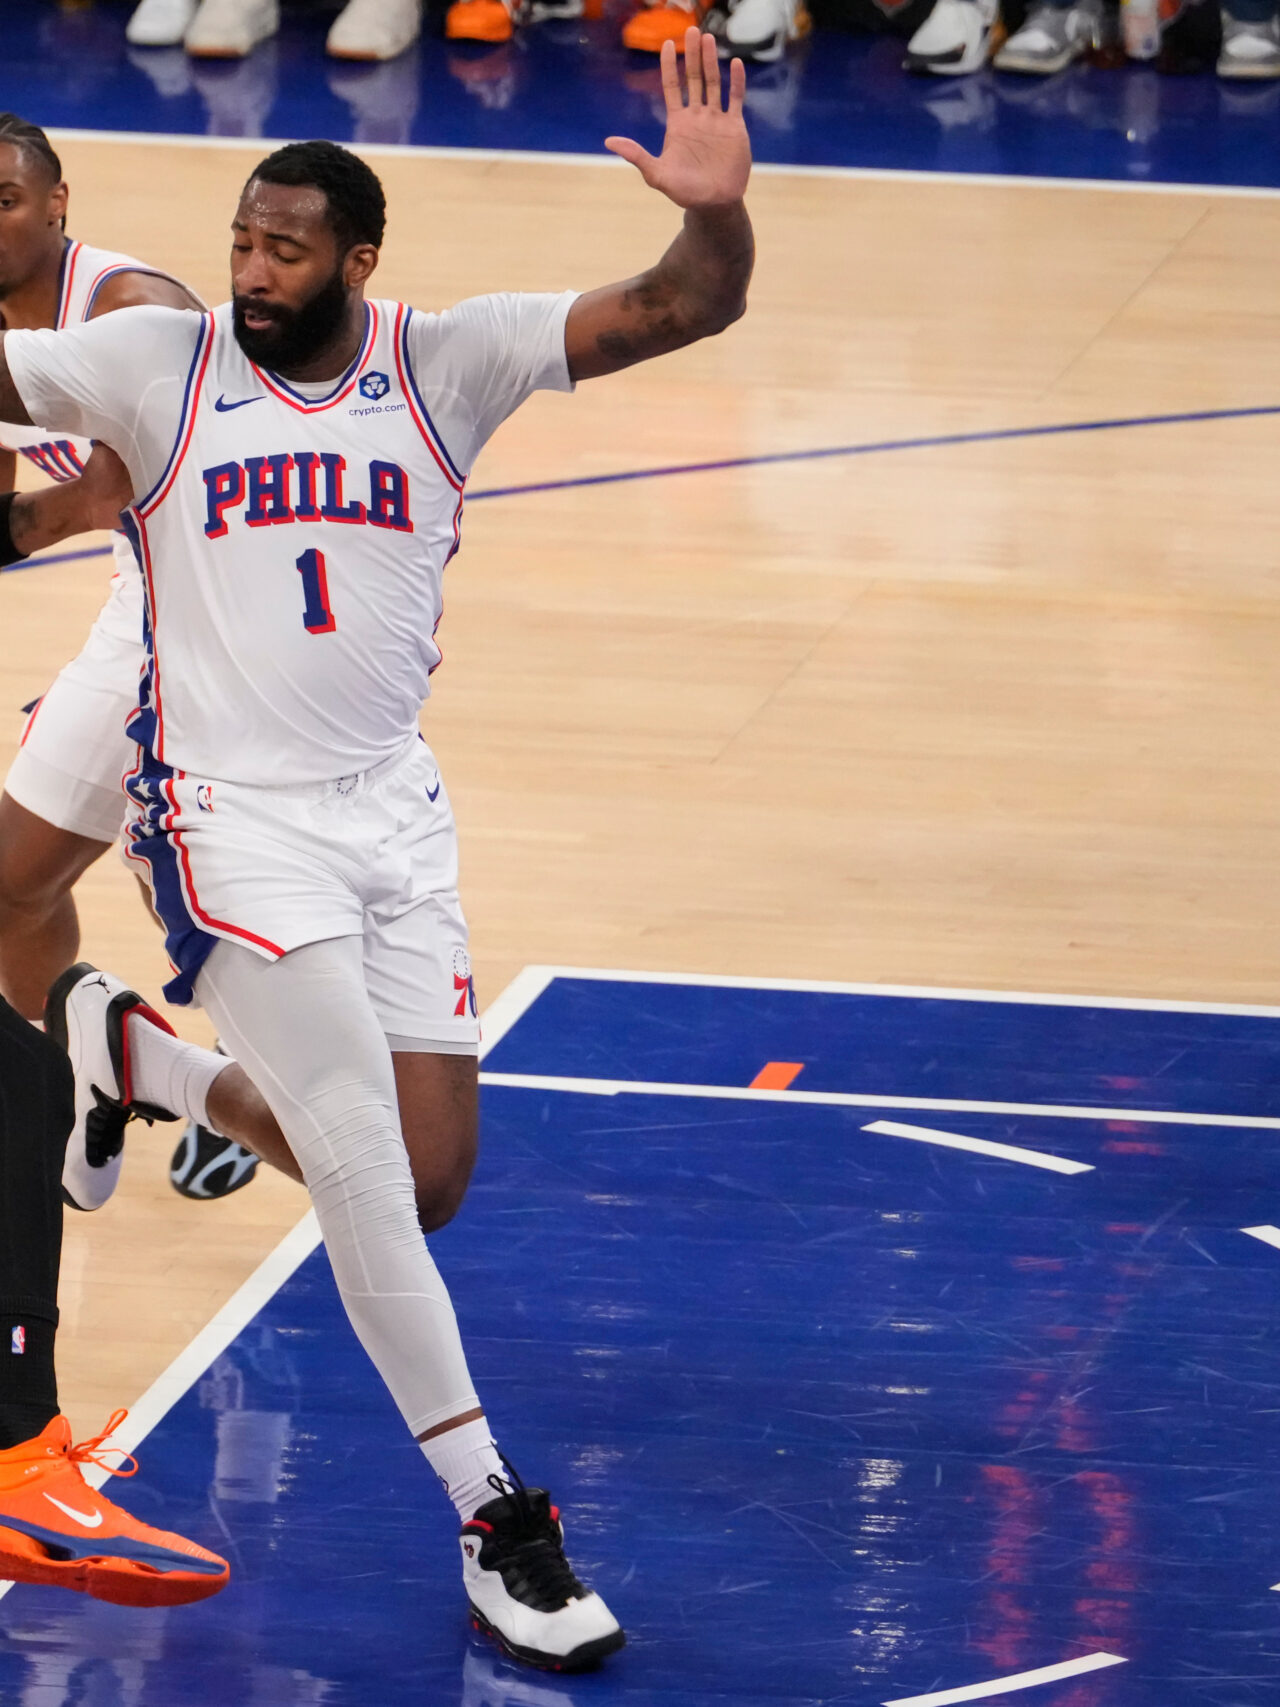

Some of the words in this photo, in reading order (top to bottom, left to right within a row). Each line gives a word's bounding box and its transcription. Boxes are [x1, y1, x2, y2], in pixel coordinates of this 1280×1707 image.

[348, 404, 407, 417] crypto.com
[202, 452, 414, 540] PHILA
[295, 547, 337, 636] 1
